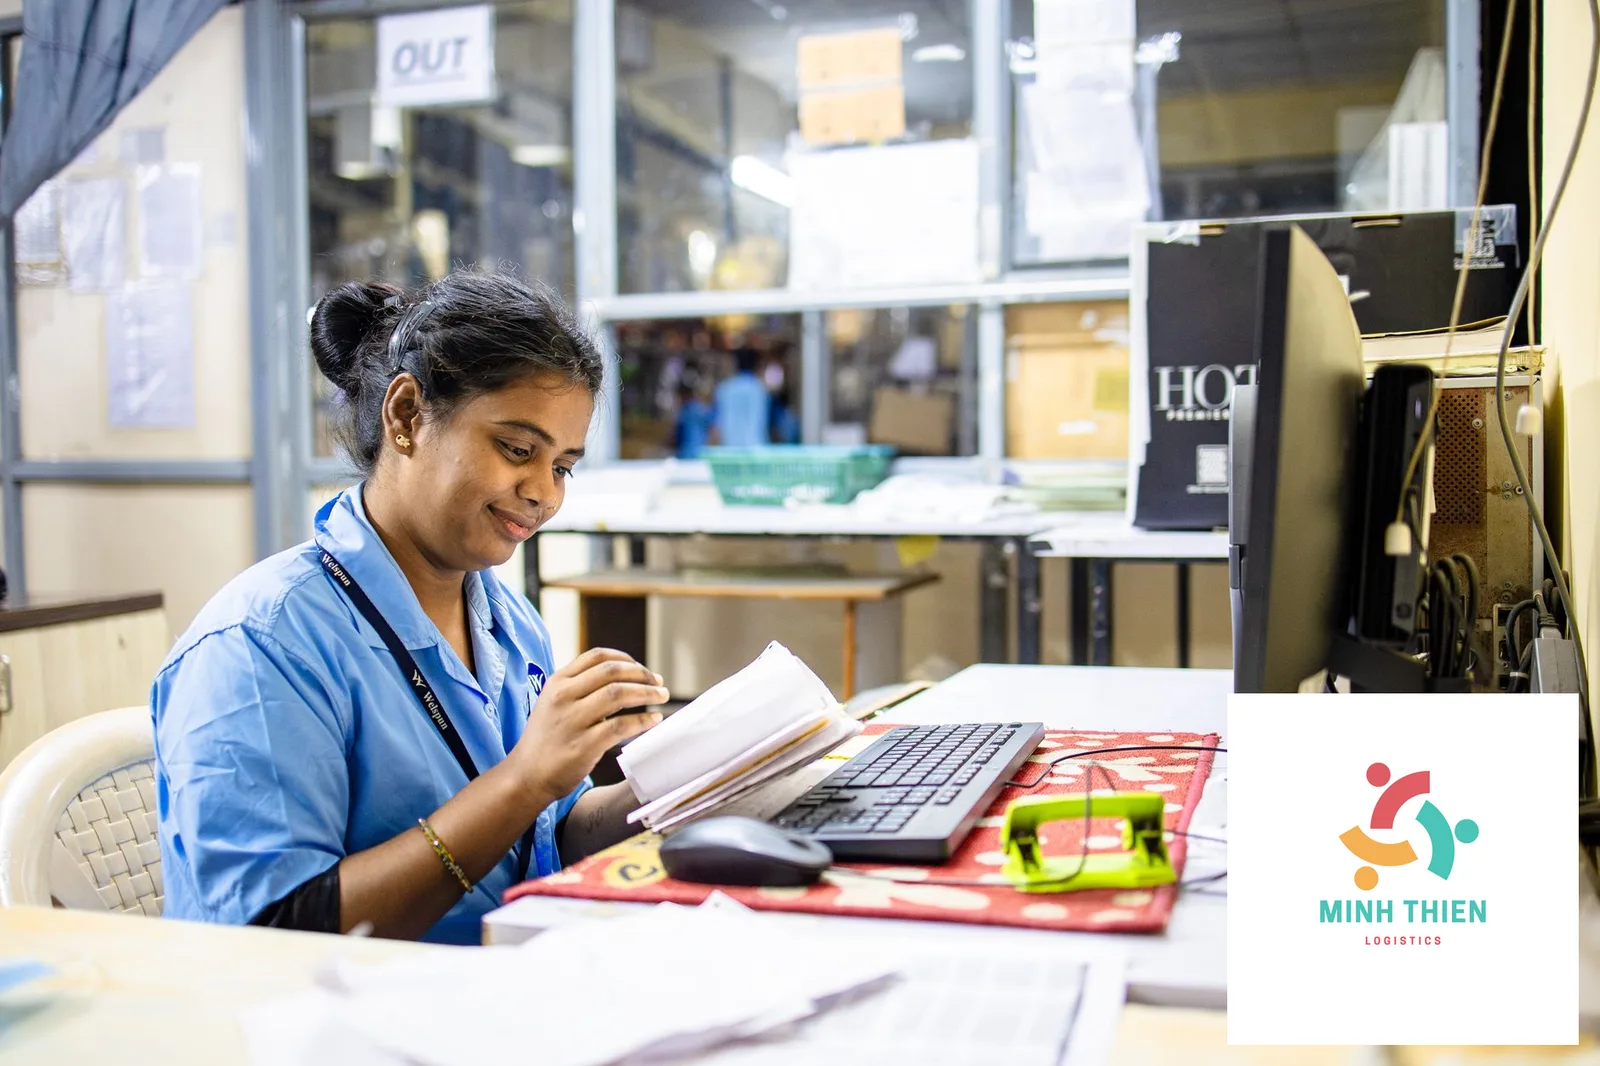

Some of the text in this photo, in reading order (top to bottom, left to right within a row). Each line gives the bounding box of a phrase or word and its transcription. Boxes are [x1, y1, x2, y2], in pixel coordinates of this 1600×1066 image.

[391, 36, 470, 77] OUT
[322, 553, 351, 587] Welspun
[423, 691, 448, 730] Welspun
